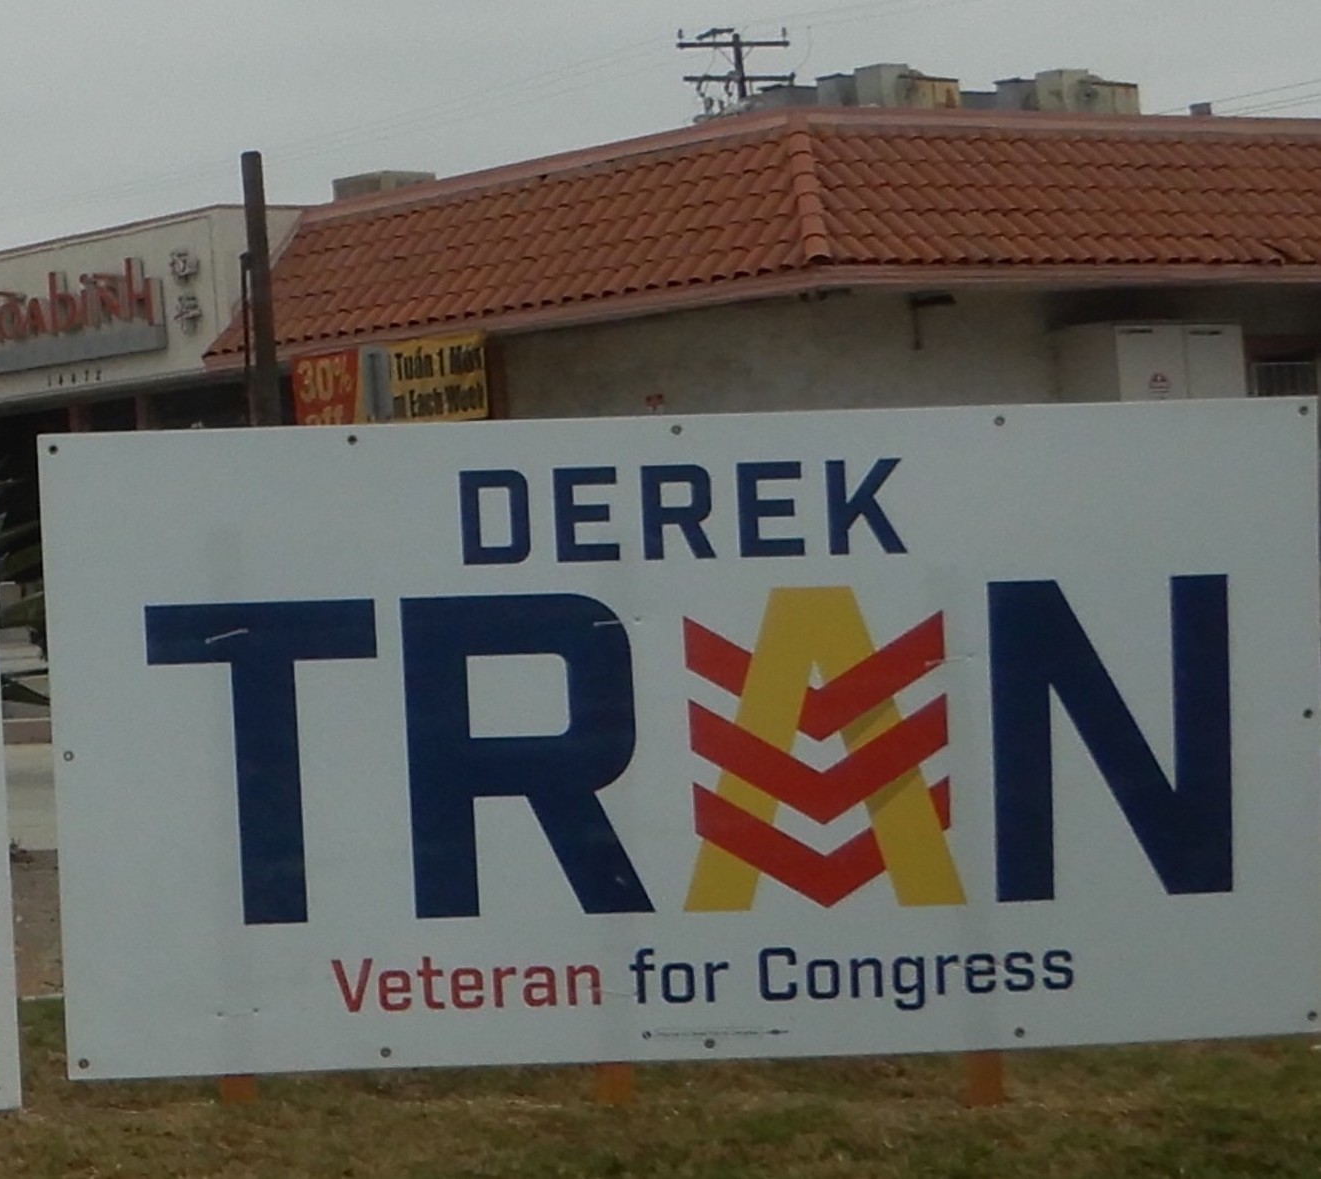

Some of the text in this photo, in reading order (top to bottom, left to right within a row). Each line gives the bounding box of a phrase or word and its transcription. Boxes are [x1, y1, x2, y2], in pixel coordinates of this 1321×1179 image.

[297, 355, 353, 403] 30%
[459, 458, 909, 565] DEREK
[144, 574, 1235, 925] TRAN
[331, 945, 1076, 1013] Veteran for Congress
